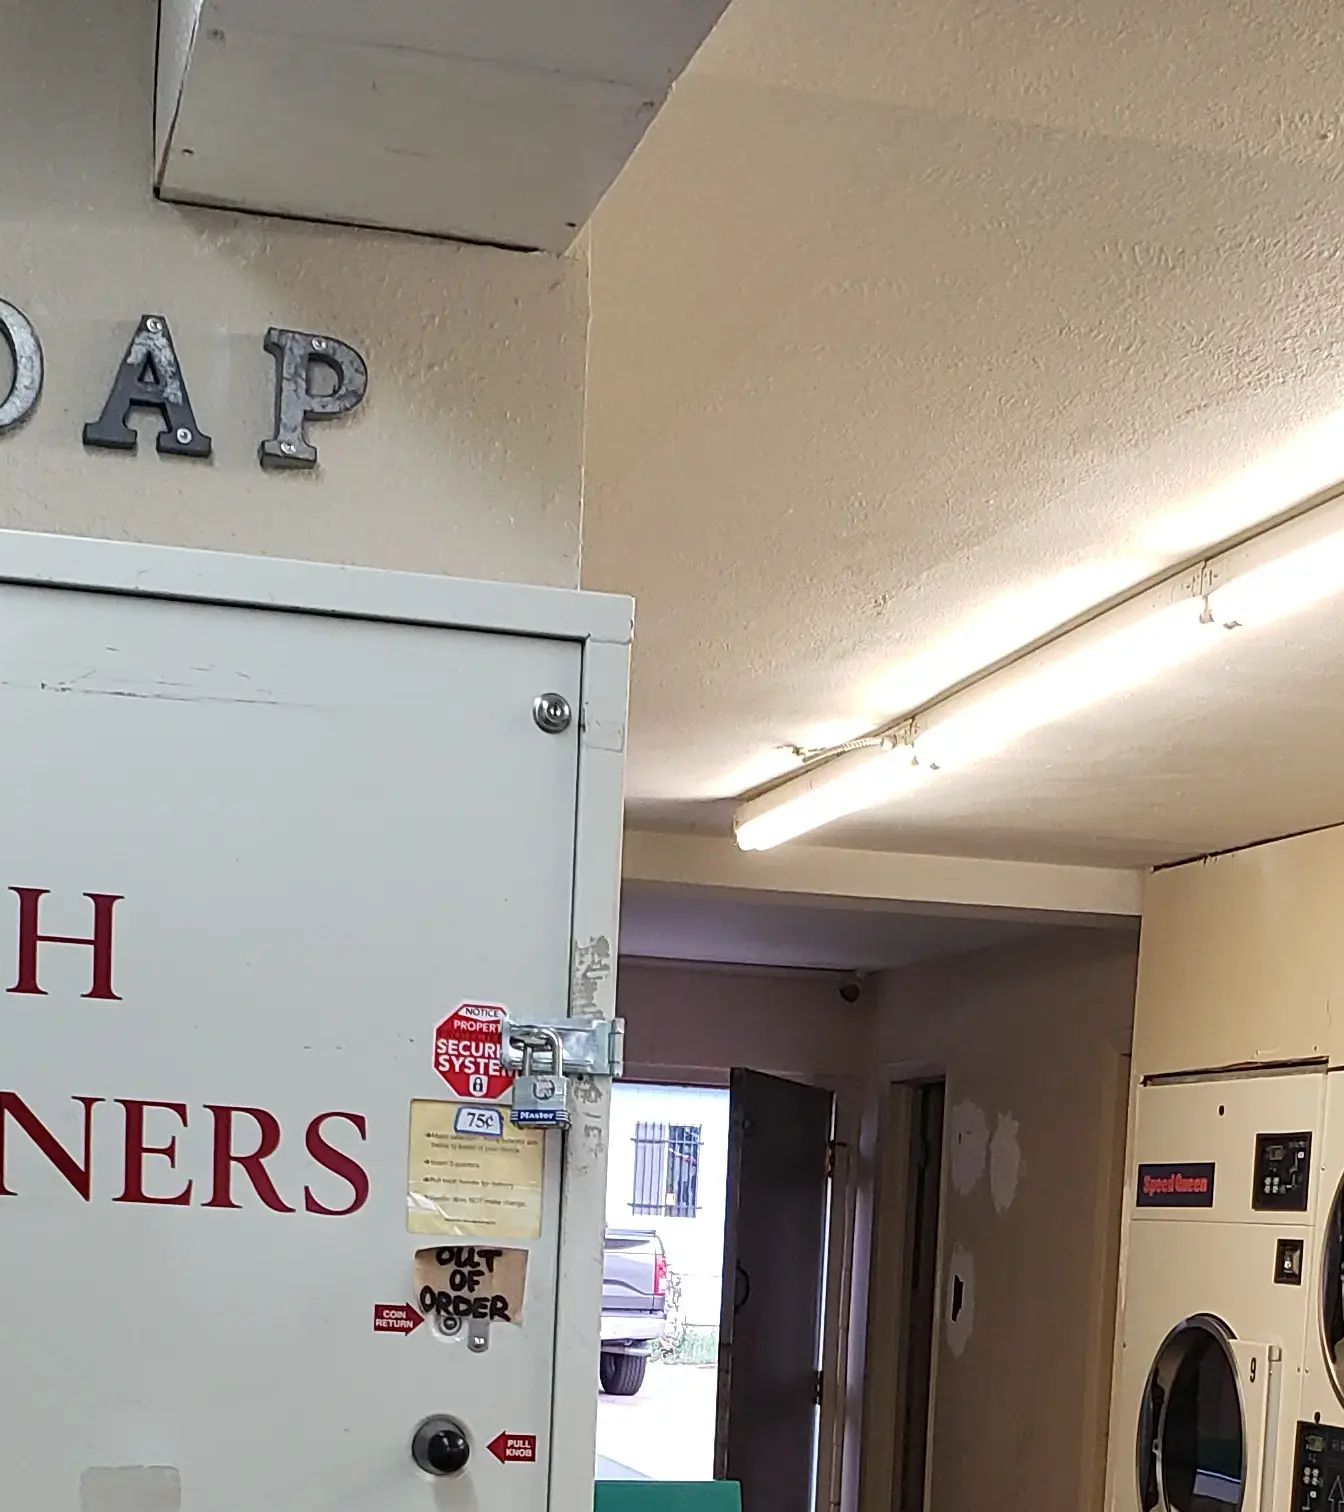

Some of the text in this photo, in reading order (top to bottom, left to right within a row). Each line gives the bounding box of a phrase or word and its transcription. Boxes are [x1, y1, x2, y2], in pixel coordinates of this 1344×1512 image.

[465, 1007, 499, 1018] NOTICE
[453, 1019, 501, 1033] PROPERT
[436, 1038, 500, 1058] SECURI
[466, 1112, 494, 1128] 75¢
[520, 1111, 554, 1120] Master
[1143, 1173, 1208, 1196] Speed Queen
[436, 1246, 503, 1273] OUT
[449, 1269, 484, 1293] OF
[419, 1285, 511, 1322] ORDER
[382, 1310, 407, 1320] COIN
[375, 1318, 414, 1329] RETURN
[1249, 1357, 1257, 1383] 9
[507, 1439, 531, 1449] PULL
[506, 1448, 532, 1458] KNOB
